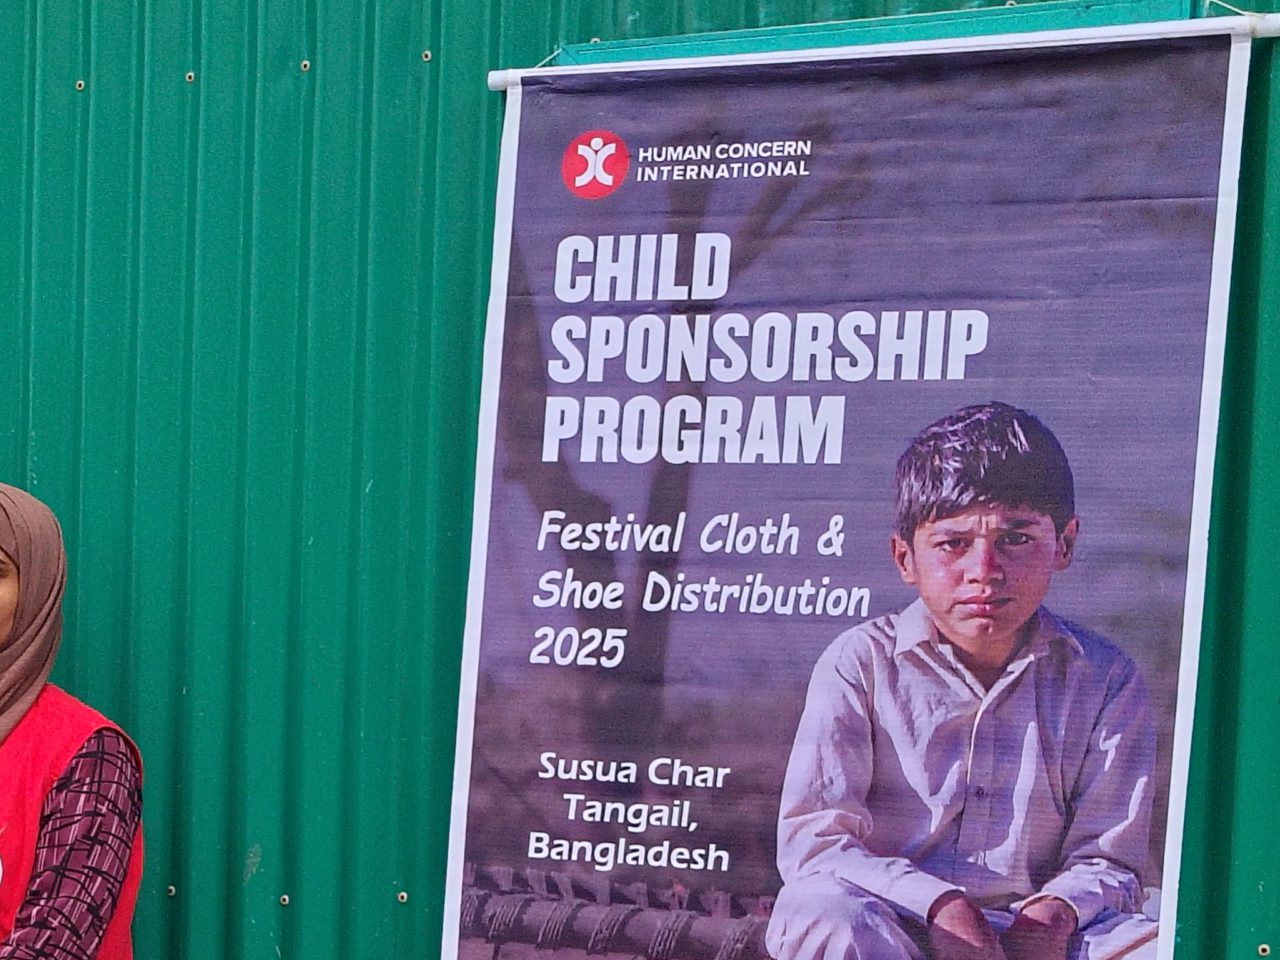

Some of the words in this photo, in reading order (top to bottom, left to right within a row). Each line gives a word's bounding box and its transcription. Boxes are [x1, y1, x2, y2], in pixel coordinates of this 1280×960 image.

[636, 160, 810, 182] INTERNATIONAL
[637, 144, 711, 163] HUMAN
[715, 139, 812, 160] CONCERN
[554, 232, 732, 303] CHILD
[547, 309, 989, 383] SPONSORSHIP
[541, 395, 846, 464] PROGRAM
[536, 510, 687, 553] Festival
[699, 512, 800, 555] Cloth
[816, 514, 845, 557] &
[532, 568, 624, 610] Shoe
[642, 571, 871, 617] Distribution
[529, 626, 628, 668] 2025
[538, 751, 637, 783] Susua
[648, 757, 732, 788] Char
[562, 793, 698, 832] Tangail,
[527, 831, 730, 872] Bangladesh
